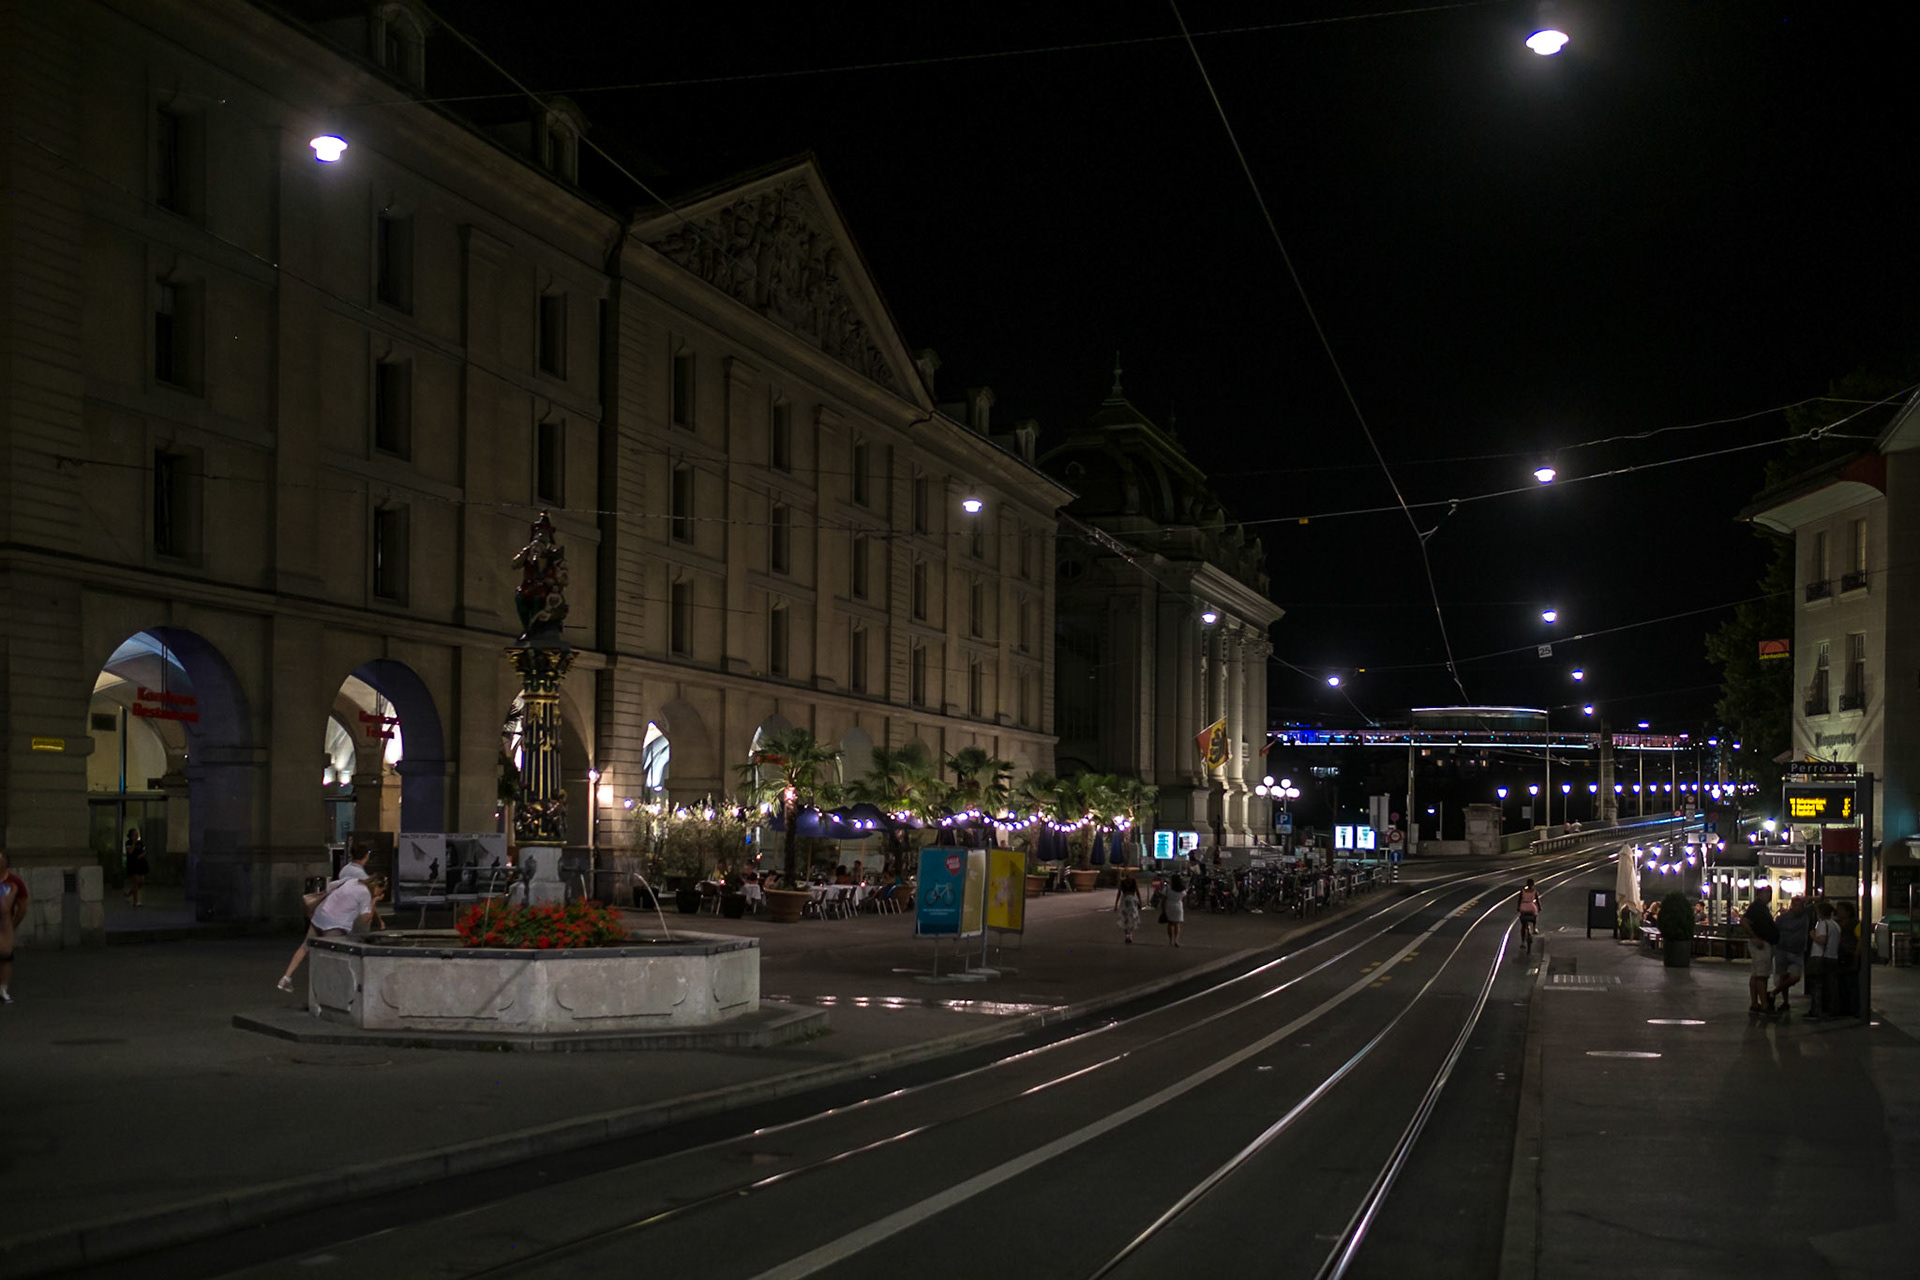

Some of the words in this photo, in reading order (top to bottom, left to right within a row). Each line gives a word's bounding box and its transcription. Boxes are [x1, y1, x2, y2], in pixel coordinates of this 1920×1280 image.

[1539, 646, 1551, 656] 25
[1790, 763, 1837, 773] Perron
[1279, 814, 1289, 824] P
